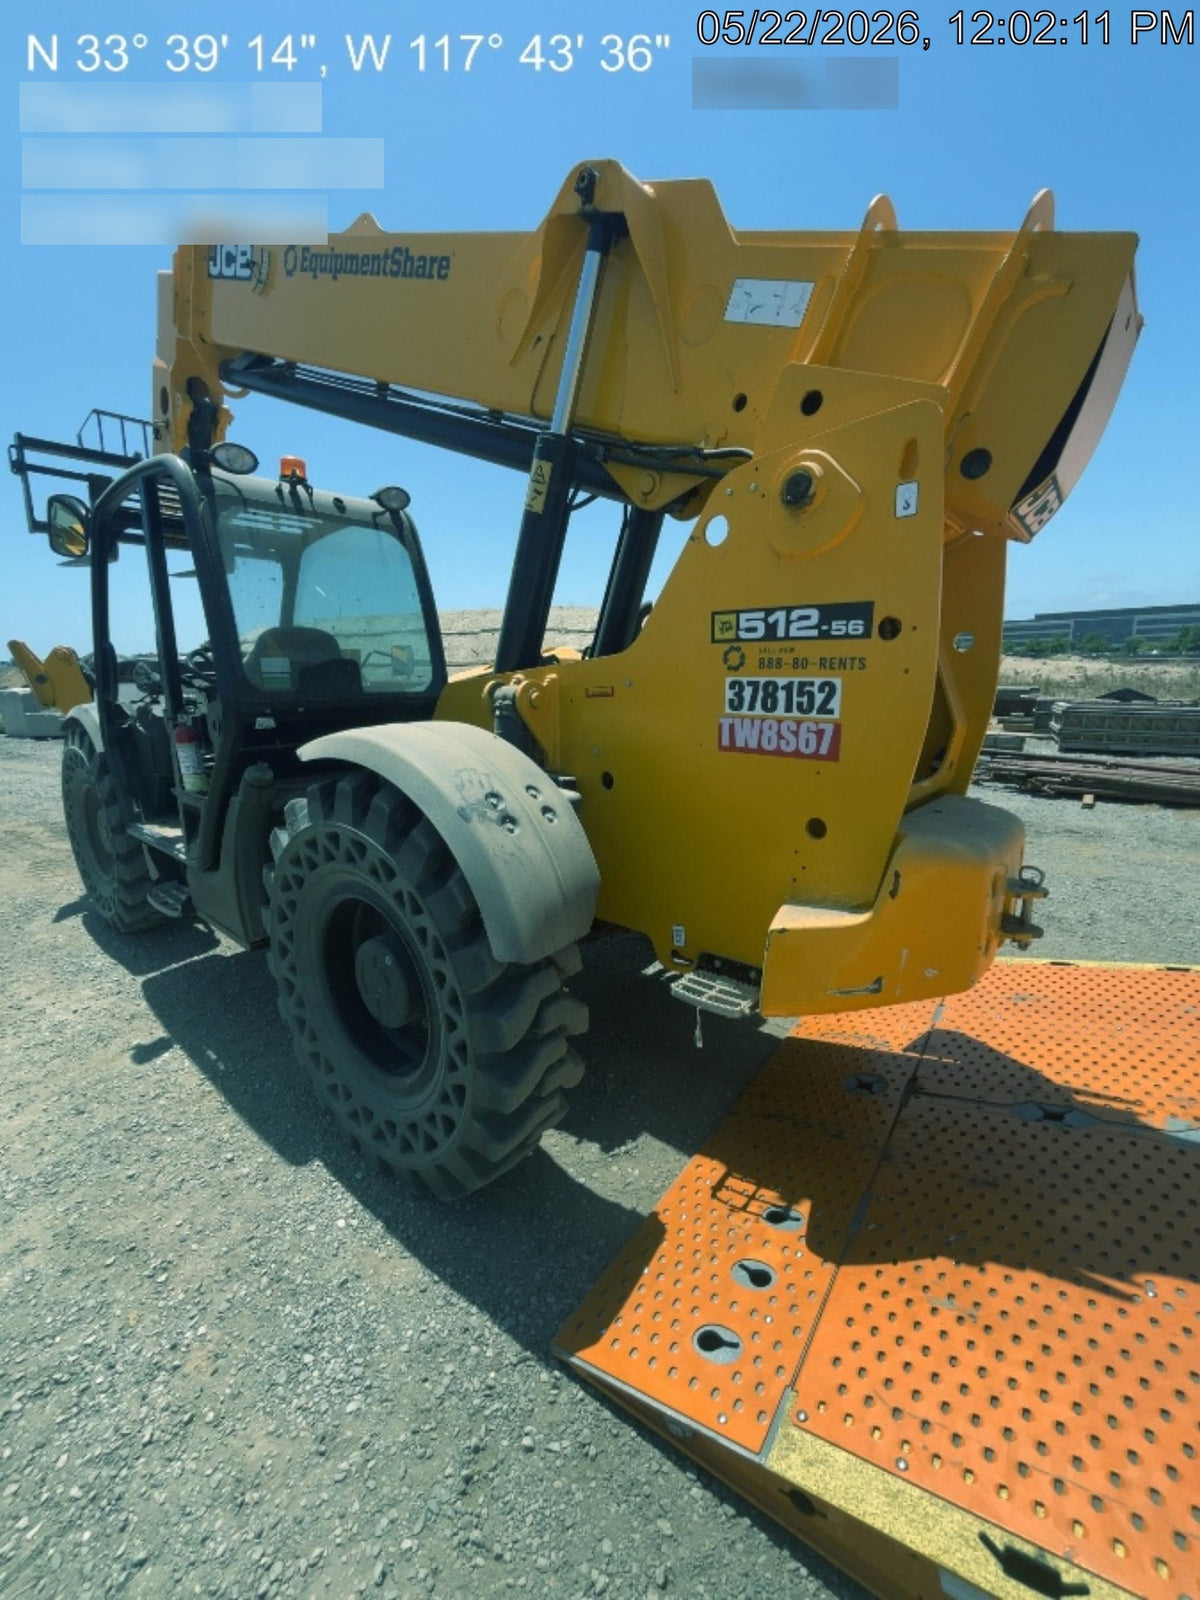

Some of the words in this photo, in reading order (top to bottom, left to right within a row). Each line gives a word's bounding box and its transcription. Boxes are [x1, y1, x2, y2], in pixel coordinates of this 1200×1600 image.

[208, 245, 252, 277] JCB
[300, 247, 451, 280] EquipmentShare
[738, 608, 865, 639] 512-56
[758, 657, 867, 671] 888-80-RENTS
[728, 680, 837, 715] 378152
[719, 718, 834, 755] TW8S67
